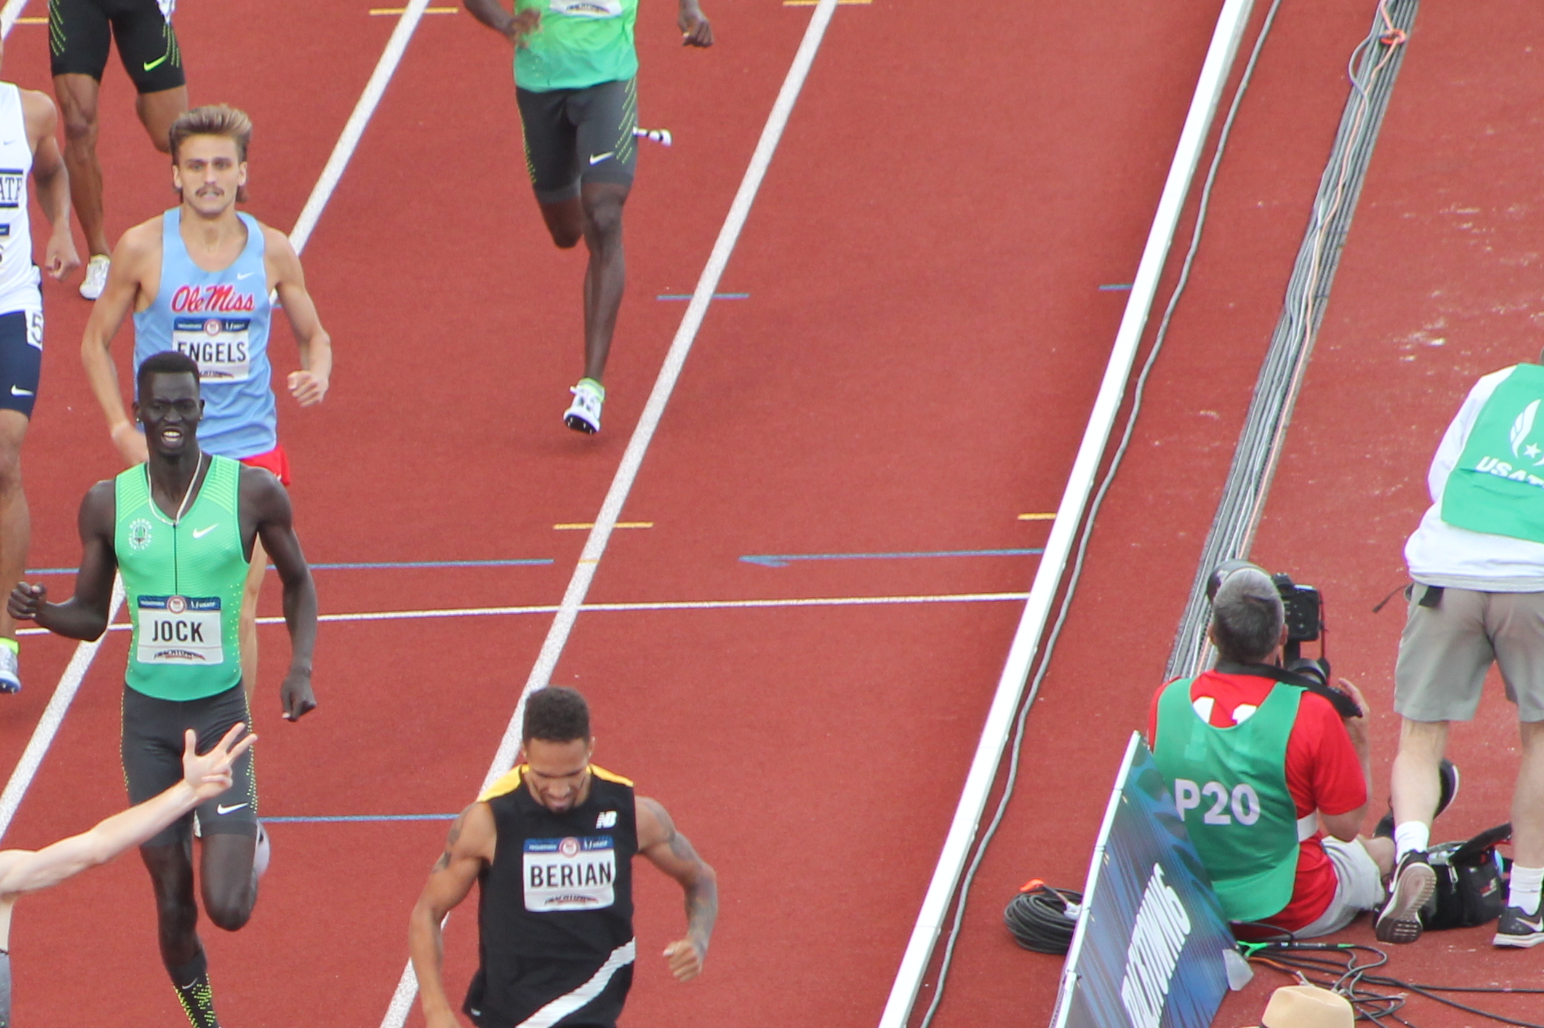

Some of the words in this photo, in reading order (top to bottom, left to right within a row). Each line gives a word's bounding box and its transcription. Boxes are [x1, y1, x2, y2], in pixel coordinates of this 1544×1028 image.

[171, 285, 204, 313] Ole
[205, 284, 255, 312] Miss
[177, 341, 247, 363] ENGELS
[1475, 456, 1544, 488] USAT
[152, 620, 204, 643] JOCK
[1175, 778, 1261, 826] P20
[530, 861, 612, 889] BERIAN
